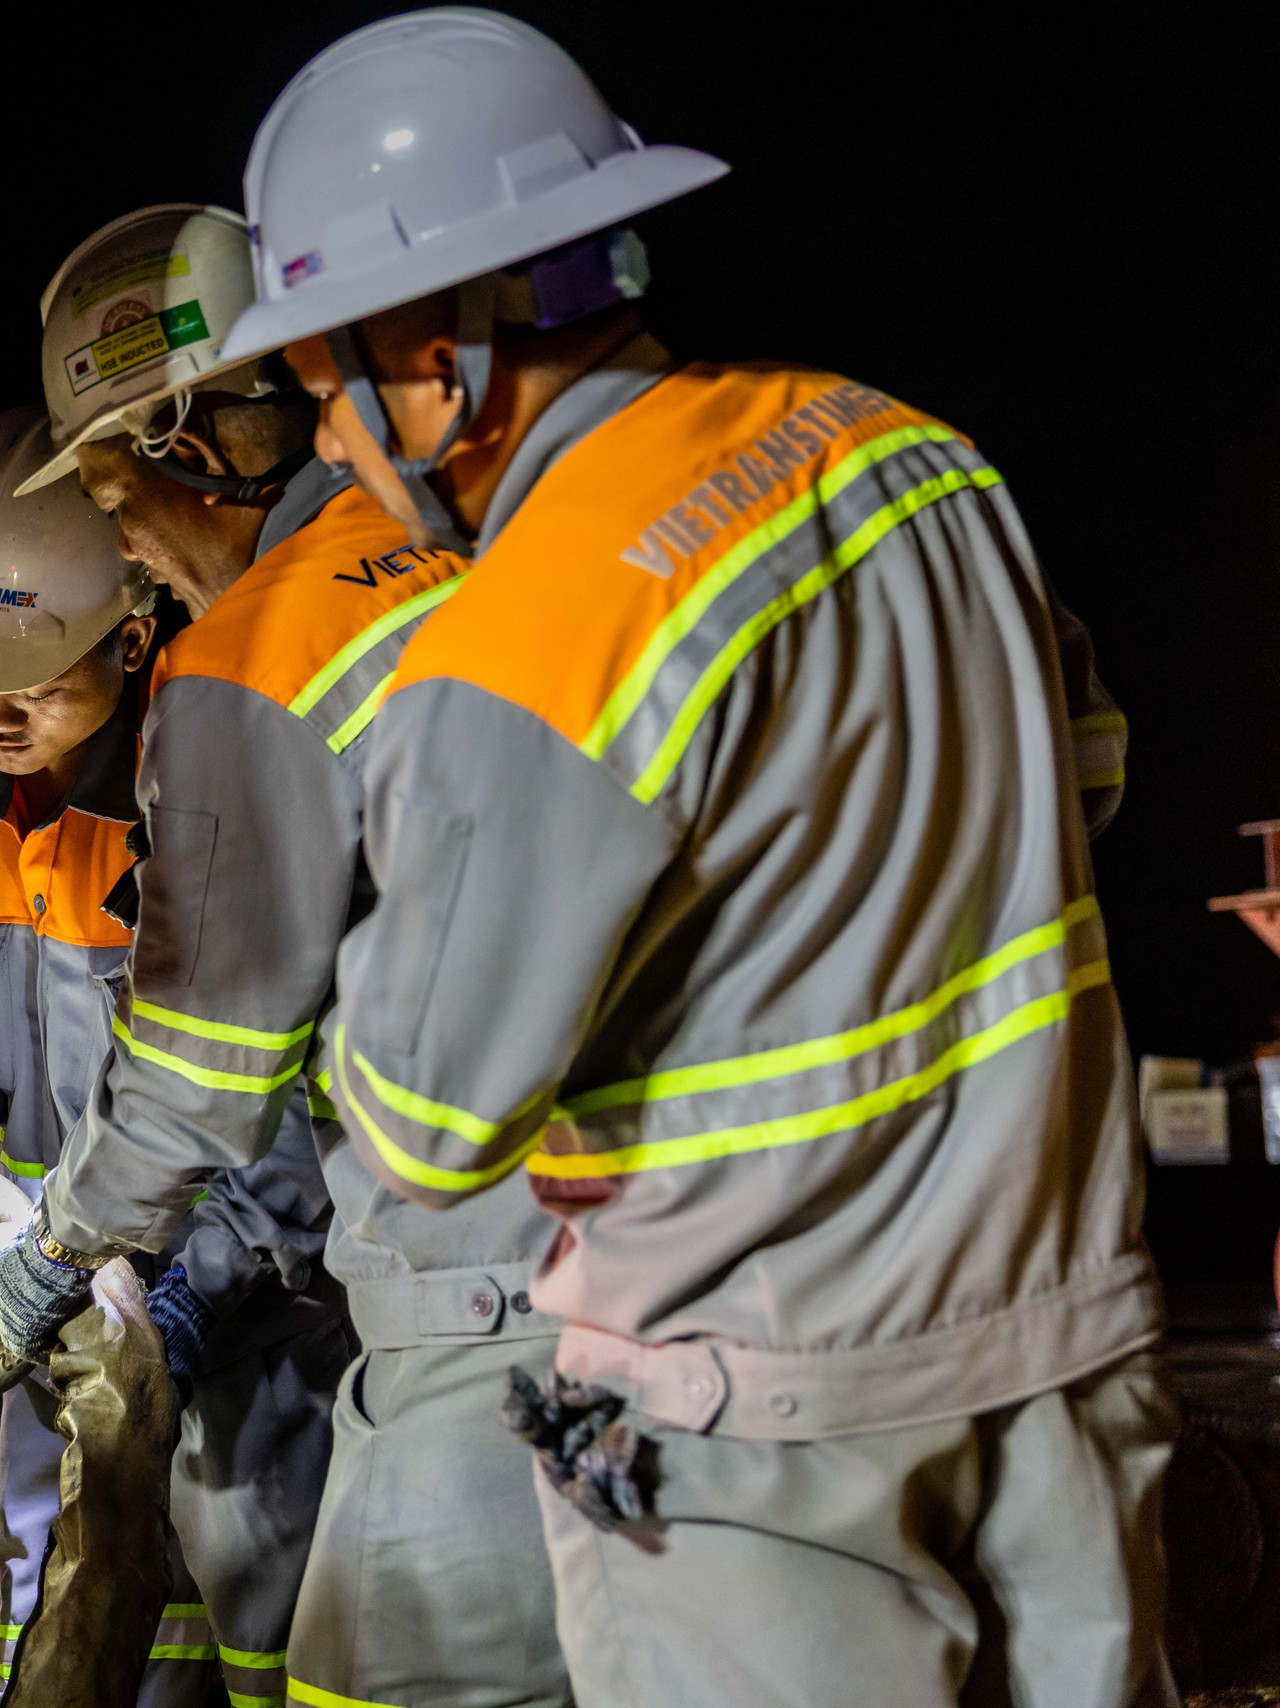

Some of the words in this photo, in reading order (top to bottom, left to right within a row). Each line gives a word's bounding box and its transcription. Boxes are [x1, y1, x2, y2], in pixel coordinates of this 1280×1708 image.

[100, 357, 118, 373] HSE
[119, 337, 164, 363] INDUCTED
[333, 543, 440, 588] VIET
